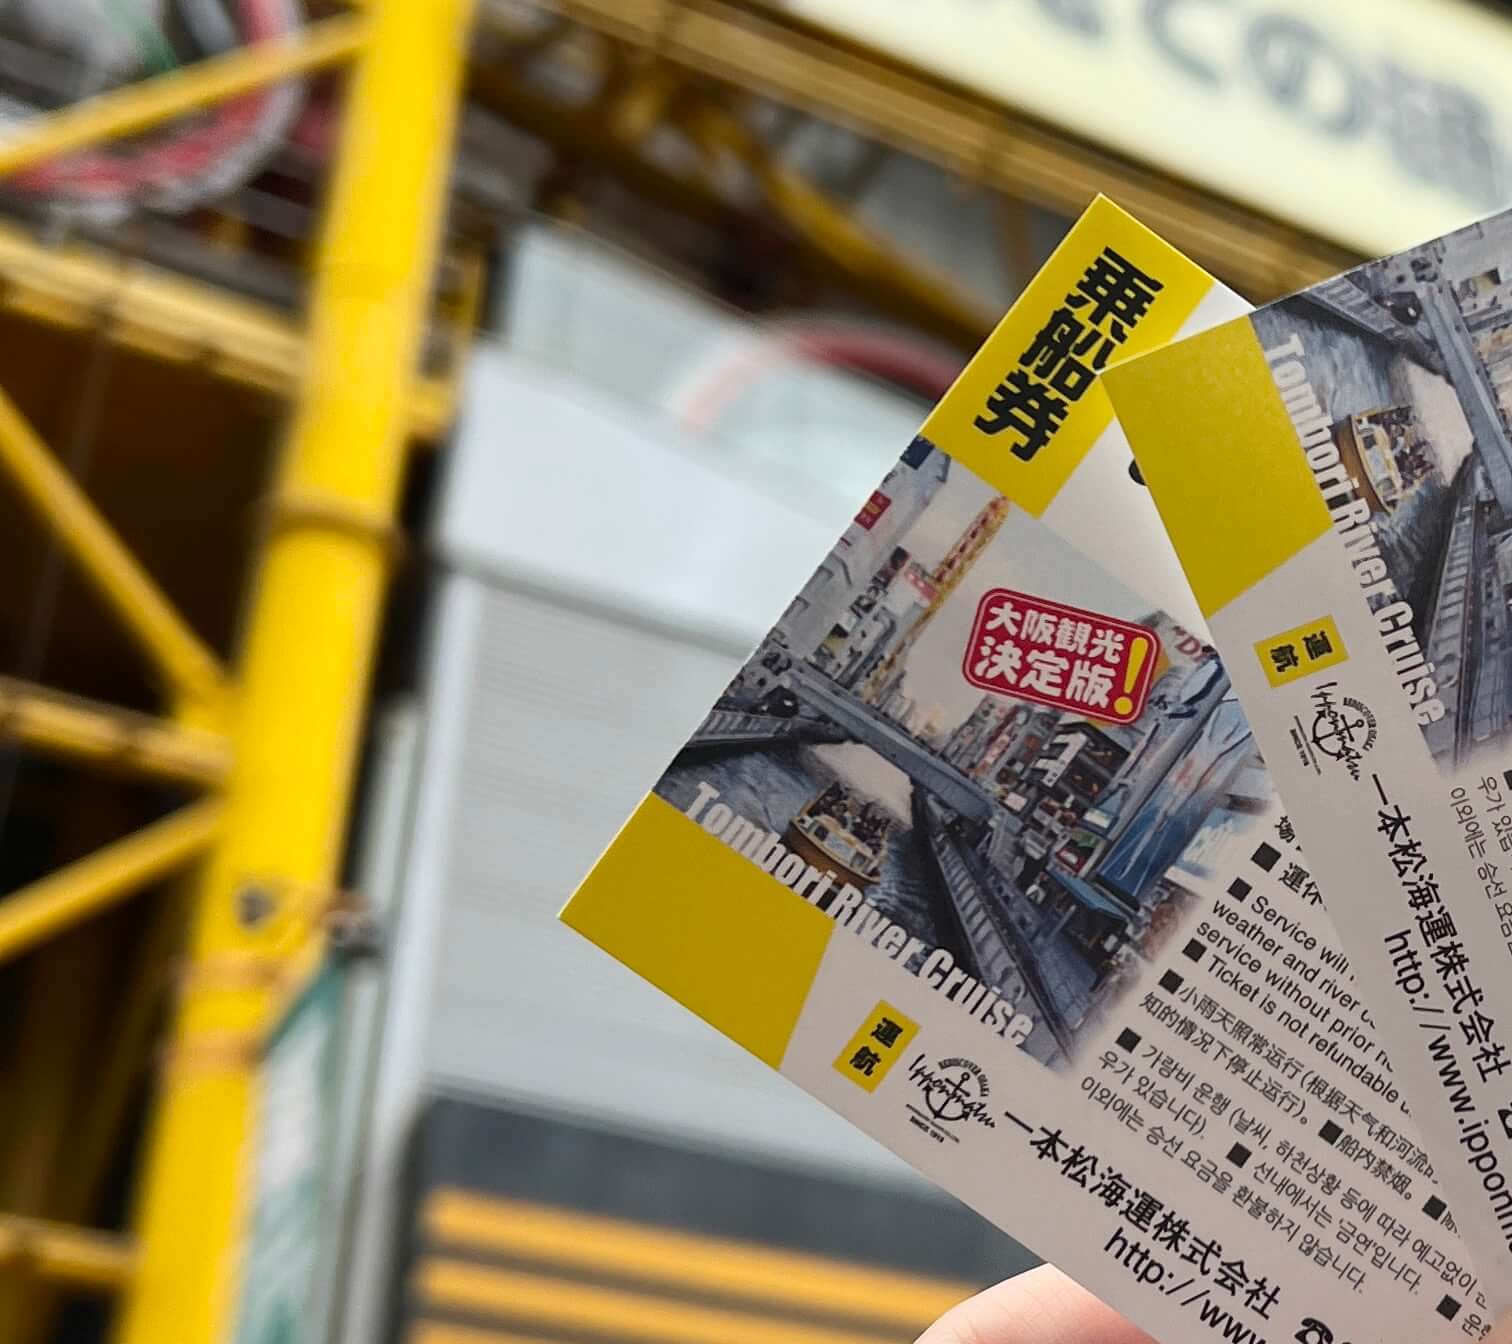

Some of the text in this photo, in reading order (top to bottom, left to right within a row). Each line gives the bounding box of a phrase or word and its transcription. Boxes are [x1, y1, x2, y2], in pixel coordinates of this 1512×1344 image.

[973, 246, 1164, 462] 乗船券
[1263, 334, 1449, 728] Tombori River Cruise
[985, 605, 1124, 664] 大阪観光
[1269, 630, 1333, 672] 運航
[1449, 786, 1486, 859] 이외에는
[1476, 862, 1507, 899] 승선
[1477, 776, 1505, 812] 우가
[681, 781, 1038, 1047] Tombori River Cruise
[1212, 899, 1360, 1011] weather and river
[1250, 895, 1349, 974] Service will
[1371, 773, 1511, 1083] 一本松海運株式会社
[848, 1016, 903, 1076] 運航
[1196, 921, 1262, 973] service
[1264, 968, 1330, 1022] without
[1327, 1017, 1375, 1053] prior
[1207, 954, 1260, 1002] Ticket
[1258, 993, 1276, 1015] is
[1276, 1010, 1309, 1038] not
[1307, 1032, 1399, 1103] refundable
[1080, 1075, 1366, 1293] 이외에는 승선 요금을 환불하지 않습니다.
[1098, 1050, 1135, 1085] 우가
[1132, 1075, 1206, 1135] 있습니다).
[1252, 1161, 1332, 1228] 선내에서는
[1141, 1044, 1195, 1091] 가랑비
[1191, 1081, 1231, 1116] 운행
[1275, 1140, 1341, 1196] 하천상황
[1339, 1186, 1378, 1223] 등에
[1376, 1212, 1412, 1247] 따라
[1412, 1237, 1477, 1296] 예고없이
[1335, 1134, 1412, 1200] 船内禁烟。
[1004, 1111, 1280, 1320] 一本松海運株式会社
